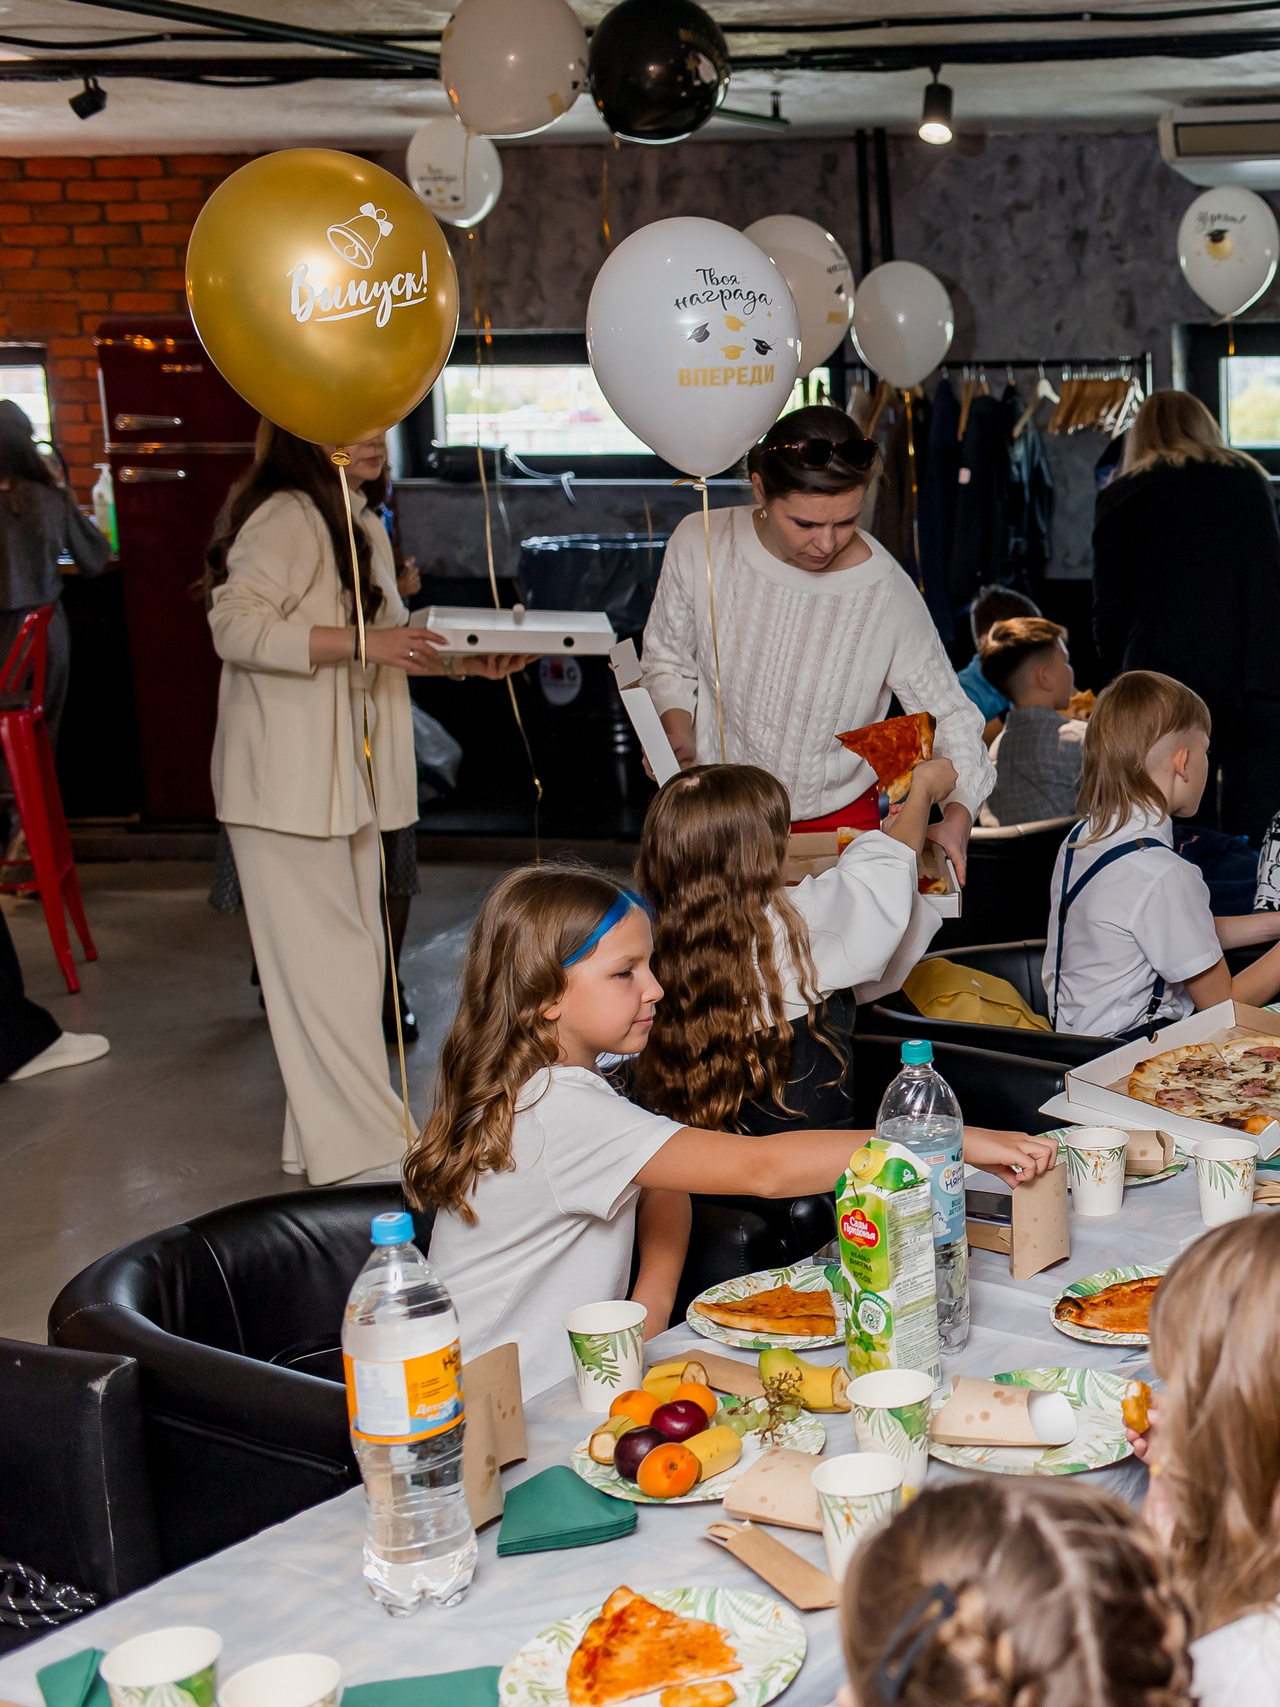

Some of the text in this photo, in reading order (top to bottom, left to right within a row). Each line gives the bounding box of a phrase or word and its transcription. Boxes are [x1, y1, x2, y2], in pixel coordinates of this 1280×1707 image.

[695, 267, 741, 286] Твоя
[286, 250, 428, 328] Выпуск!
[673, 288, 774, 316] награда
[678, 364, 775, 388] ВПЕРЕДИ
[843, 1223, 876, 1241] Придонья
[849, 1216, 868, 1230] Сады
[850, 1252, 871, 1263] ЯБЛОКО
